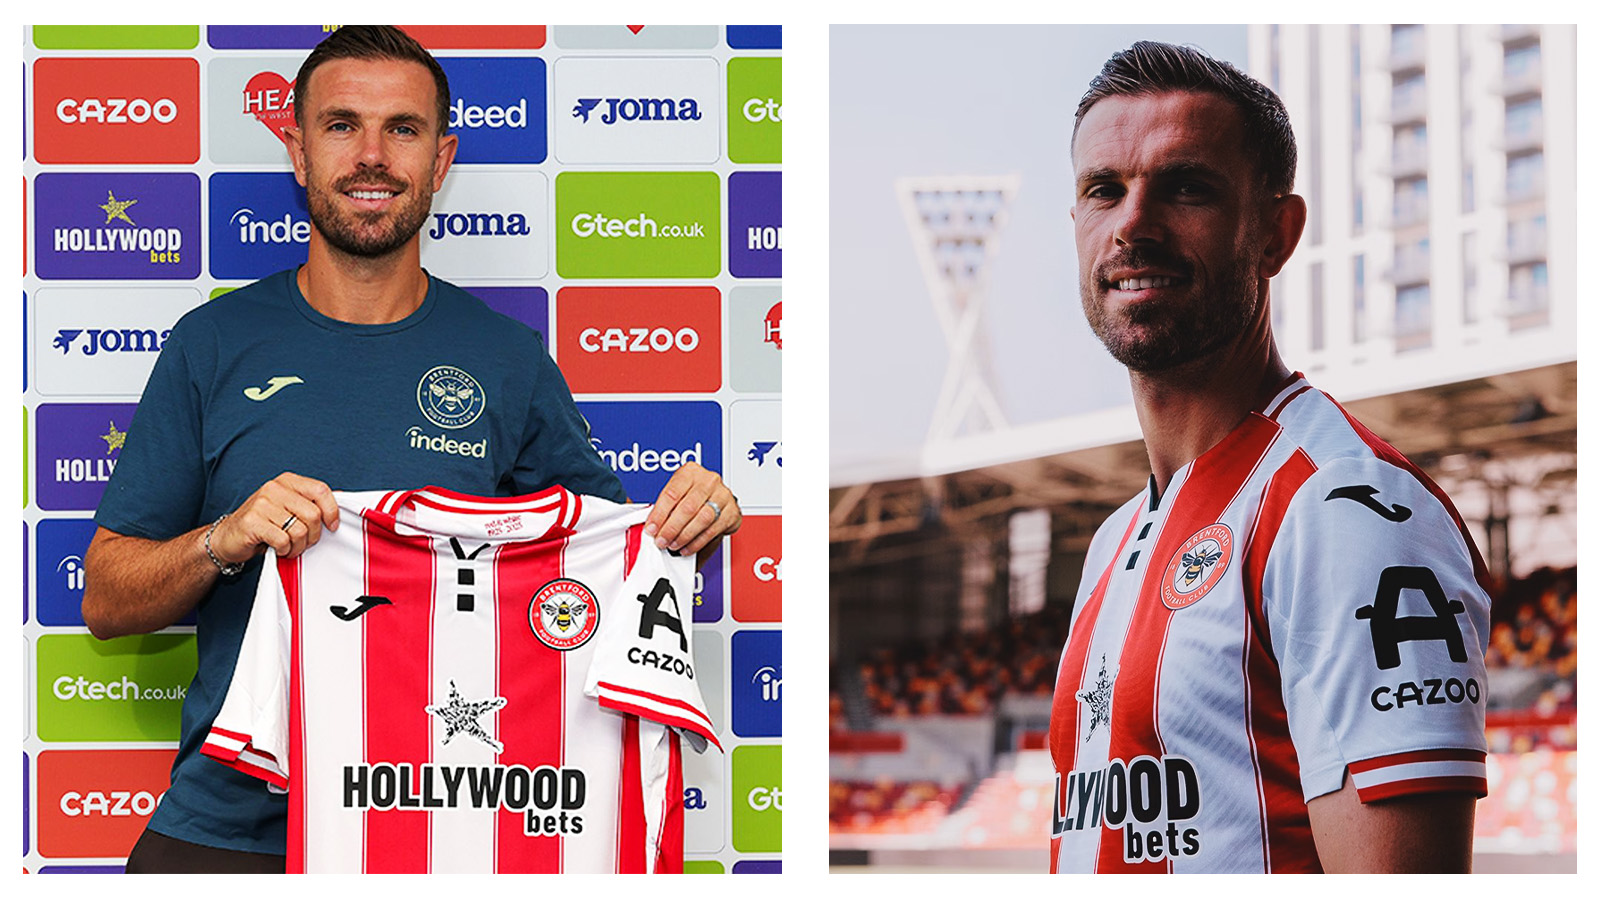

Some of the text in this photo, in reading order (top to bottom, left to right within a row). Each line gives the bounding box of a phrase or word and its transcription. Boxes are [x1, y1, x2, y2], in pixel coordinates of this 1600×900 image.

[56, 98, 178, 123] CAZOO
[449, 98, 527, 128] deed
[239, 213, 311, 243] inde
[571, 213, 706, 238] Gtech.co.uk
[54, 229, 181, 252] HOLLYWOOD
[150, 249, 180, 264] bets
[579, 327, 699, 352] CAZOO
[409, 430, 487, 458] indeed
[595, 442, 702, 472] ndeed
[1186, 528, 1230, 548] BRENTFORD
[540, 584, 589, 601] BRENTFORD
[1165, 585, 1209, 605] FOOTBALL CLUB
[627, 646, 694, 680] CAZOO
[53, 675, 186, 700] Gtech.co.uk
[1370, 677, 1480, 712] CAZOO
[343, 765, 586, 810] HOLLYWOOD
[60, 791, 165, 816] CAZO
[527, 809, 583, 834] bets
[1126, 822, 1200, 859] bets
